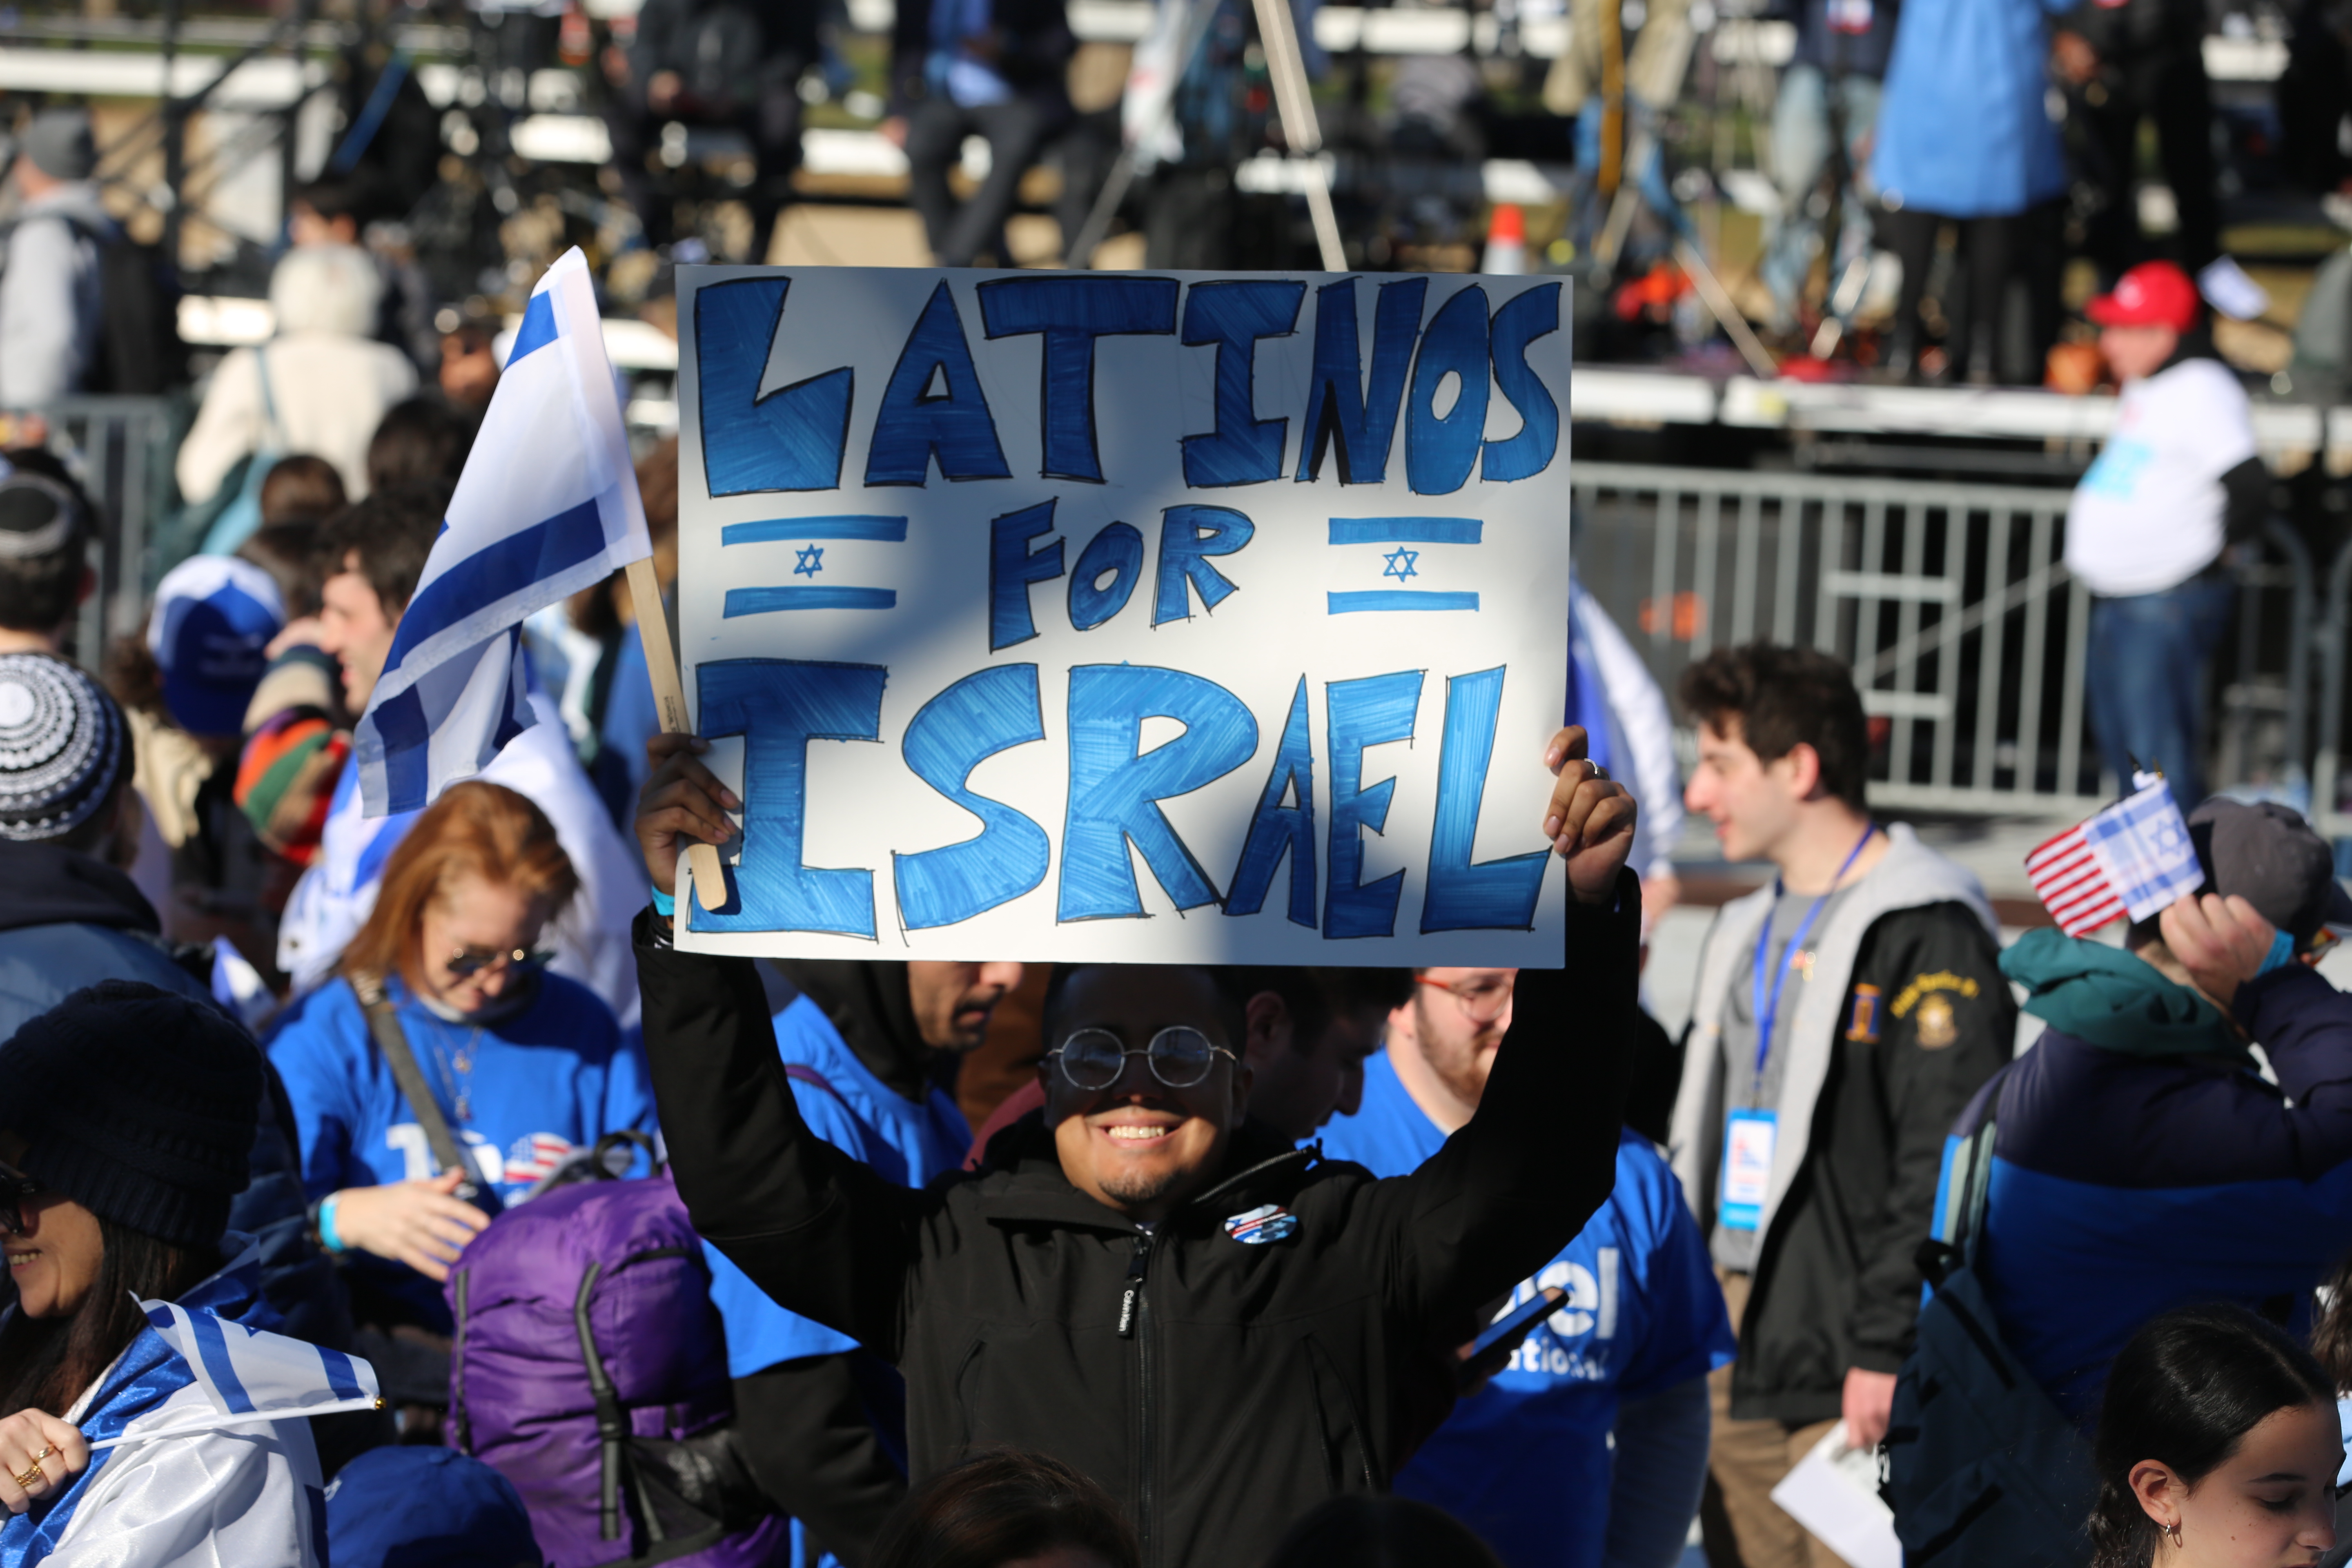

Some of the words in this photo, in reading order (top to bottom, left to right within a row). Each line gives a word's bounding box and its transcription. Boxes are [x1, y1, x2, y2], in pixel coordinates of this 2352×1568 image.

[695, 276, 1562, 497] LATINOS
[989, 497, 1255, 653] FOR
[687, 658, 1552, 944] ISRAEL
[1119, 1314, 1130, 1331] Klein
[1122, 1290, 1134, 1313] Calvin
